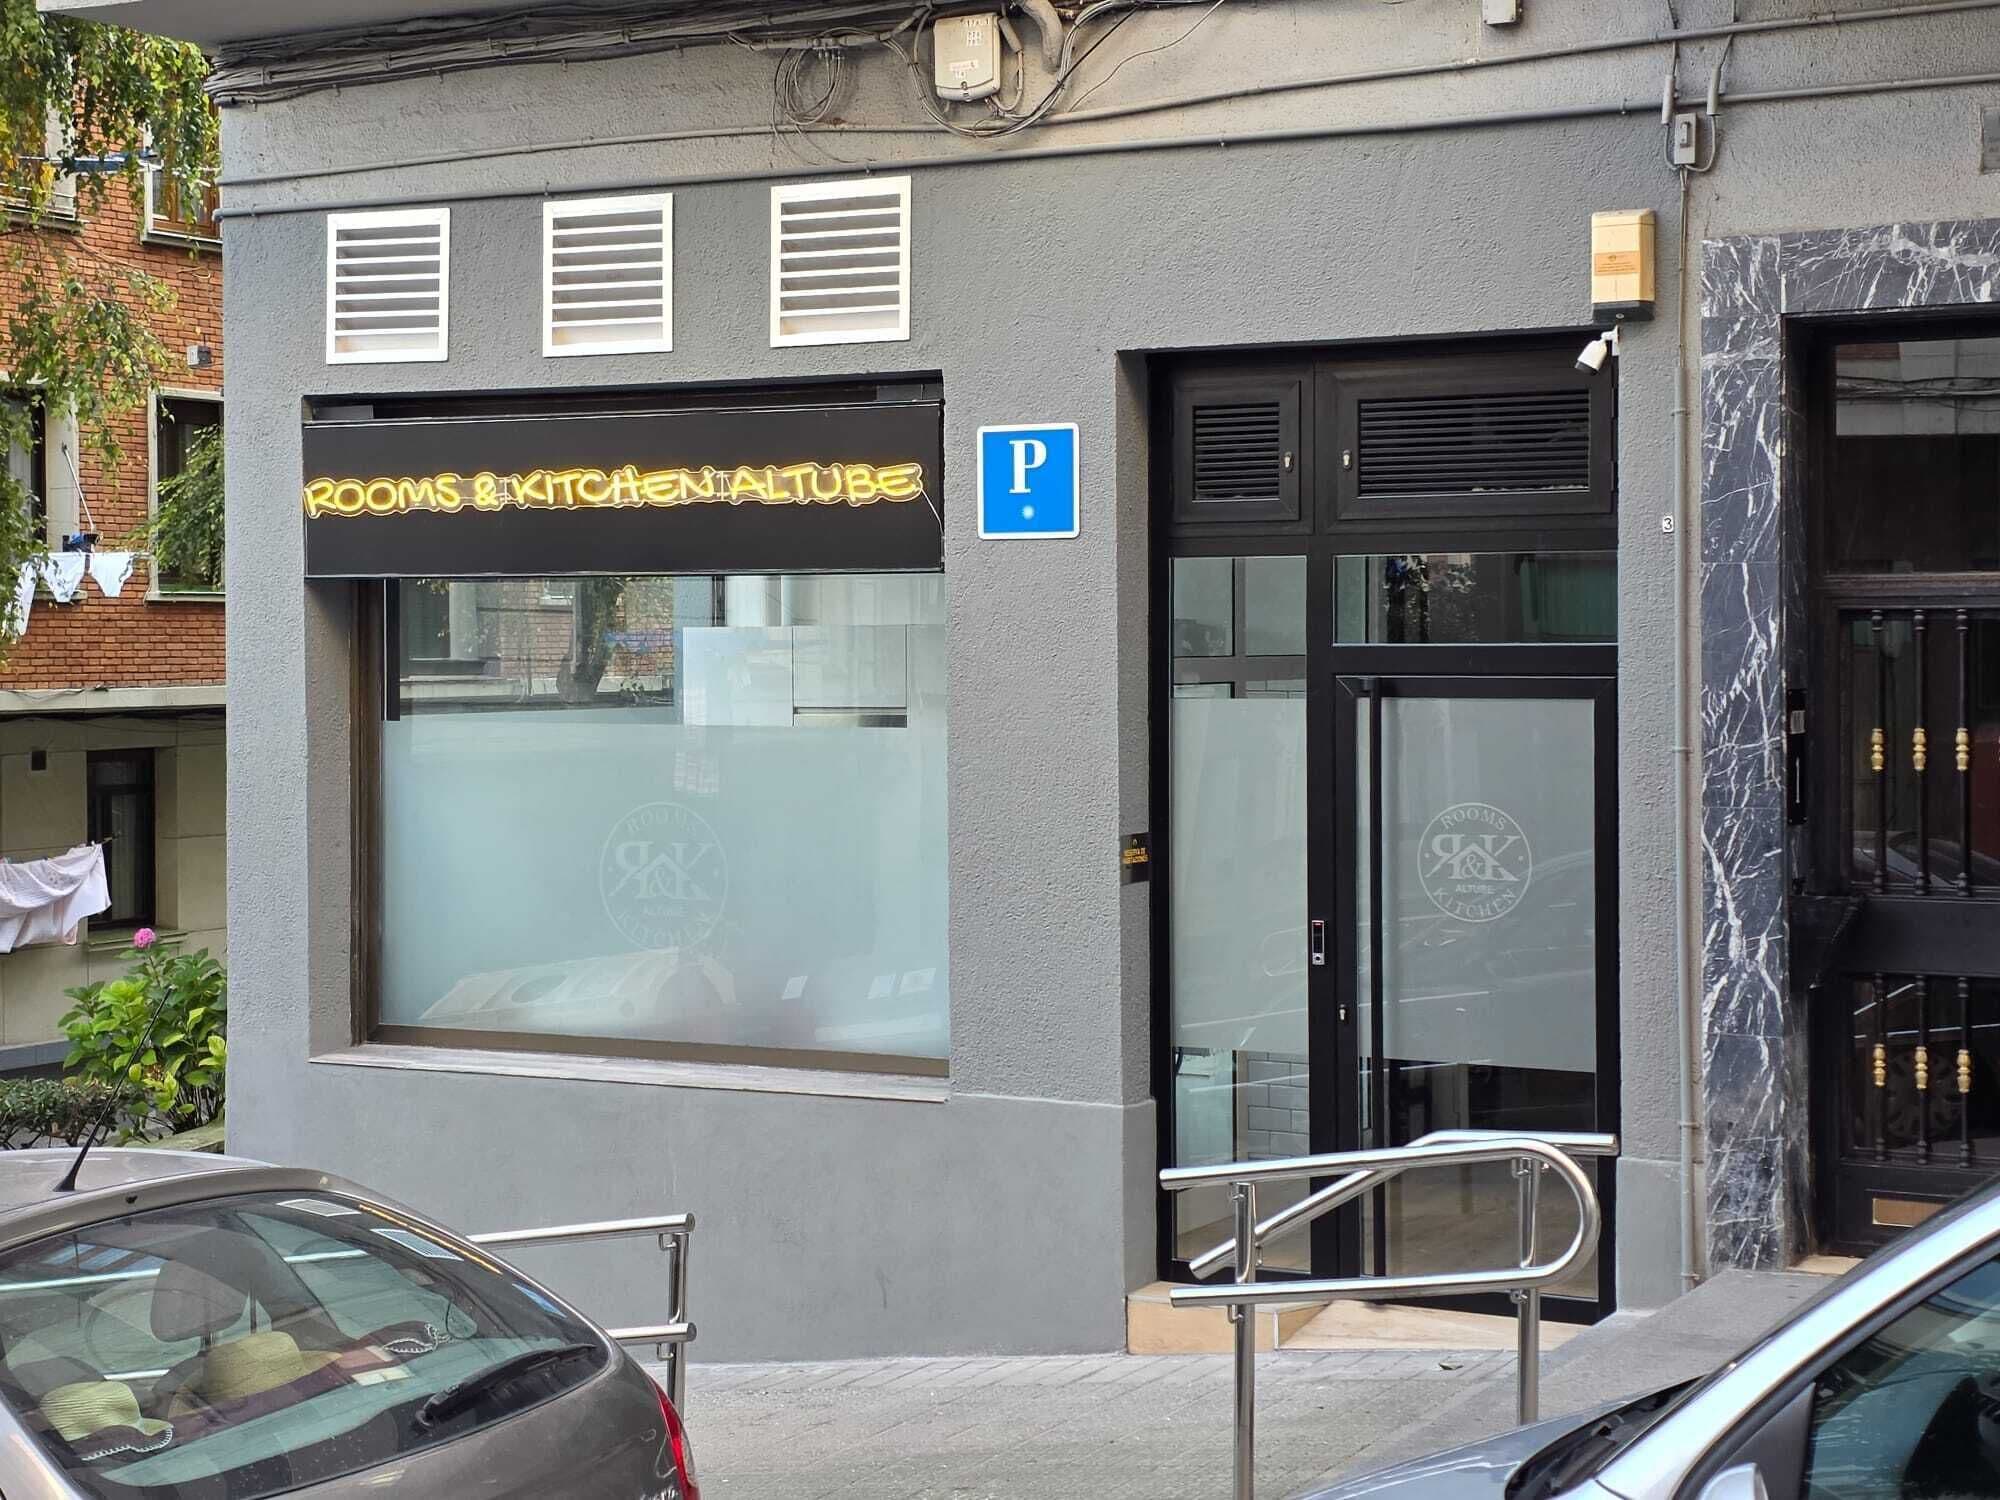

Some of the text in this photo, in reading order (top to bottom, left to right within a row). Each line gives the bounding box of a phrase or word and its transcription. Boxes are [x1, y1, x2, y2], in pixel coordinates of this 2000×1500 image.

[1008, 439, 1047, 494] P
[304, 464, 920, 517] ROOMS & KITCHEN ALTUBE
[1663, 517, 1672, 530] 3
[1441, 807, 1507, 831] ROOMS
[1433, 887, 1518, 918] KITCHEN
